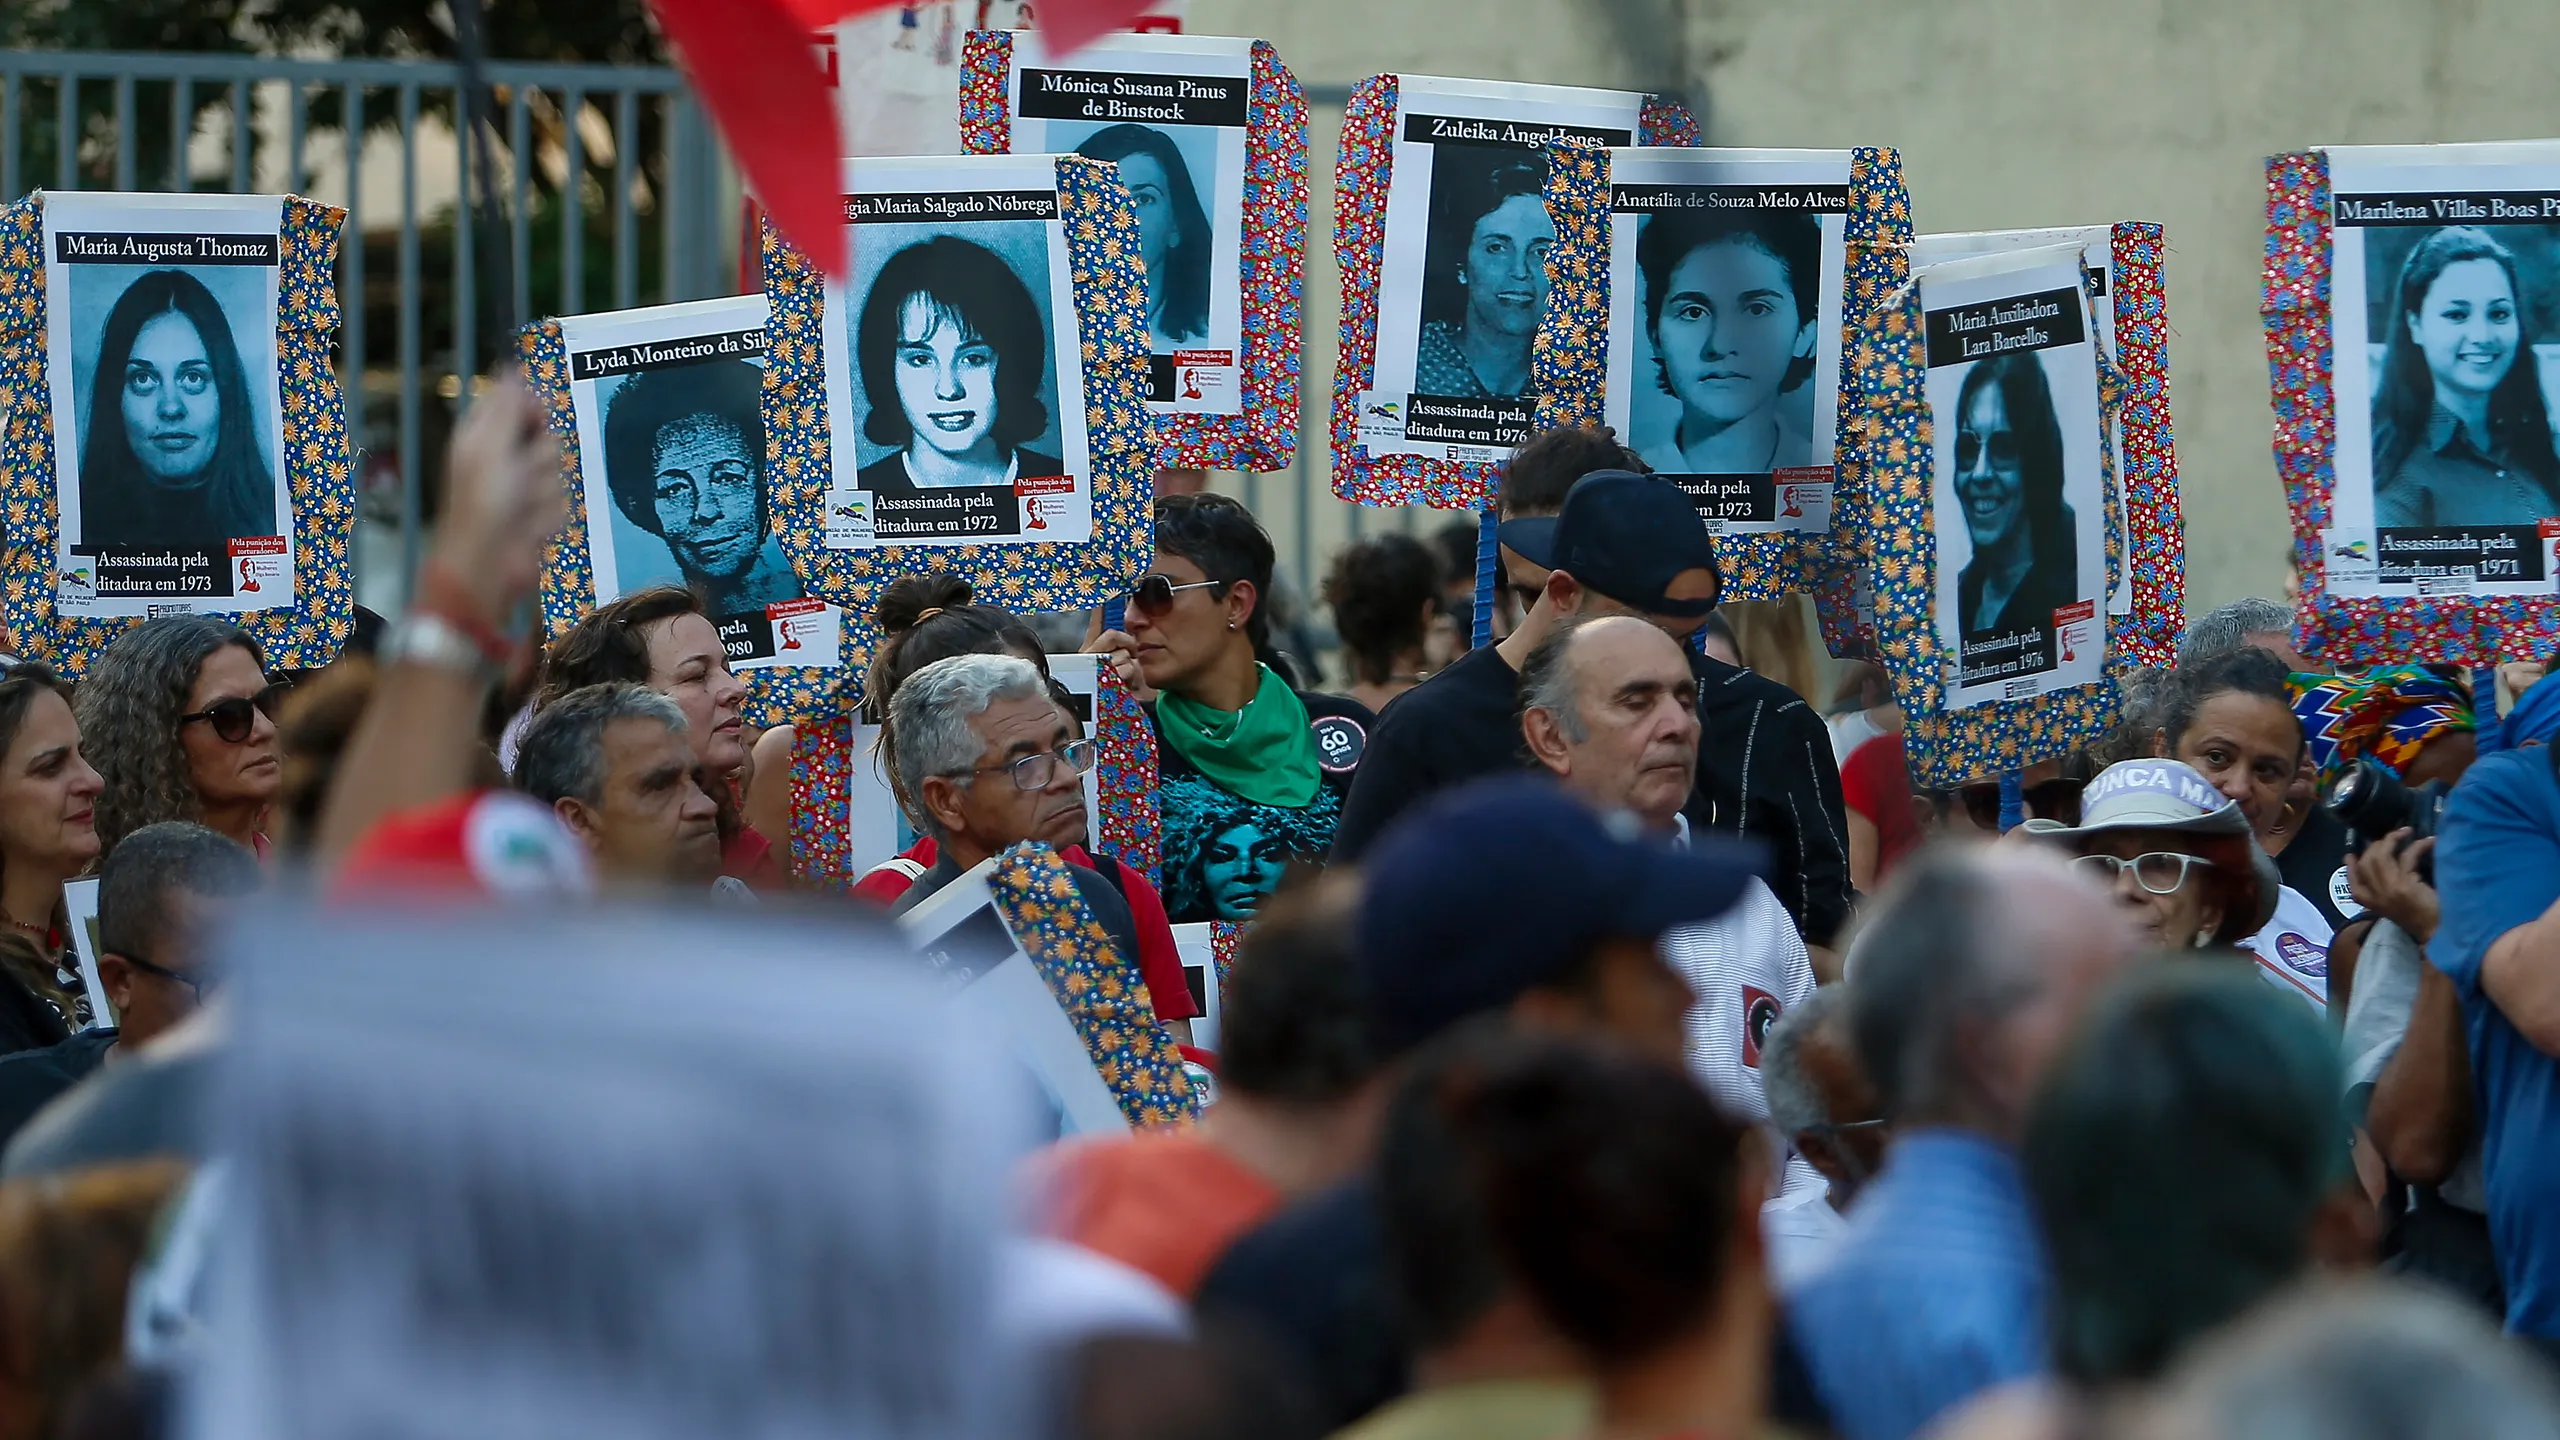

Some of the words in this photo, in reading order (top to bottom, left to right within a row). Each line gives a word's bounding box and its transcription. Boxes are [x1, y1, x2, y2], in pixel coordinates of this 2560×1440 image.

[1041, 74, 1108, 95] Mónica
[1113, 77, 1174, 97] Susana
[1178, 80, 1227, 99] Pinus
[1082, 99, 1103, 116] de
[1107, 100, 1185, 120] Binstock
[1431, 118, 1498, 141] Zuleika
[1501, 124, 1554, 149] Angel
[843, 198, 870, 220] ígia
[874, 198, 920, 215] Maria
[924, 196, 984, 218] Salgado
[987, 196, 1054, 216] Nóbrega
[1614, 191, 1682, 208] Anatália
[1686, 192, 1705, 208] de
[1708, 192, 1755, 208] Souza
[1758, 191, 1800, 208] Melo
[1802, 191, 1846, 208] Alves
[2338, 200, 2428, 221] Marilena
[2430, 198, 2487, 219] Villas
[2489, 197, 2538, 219] Boas
[66, 235, 118, 256] Maria
[122, 236, 193, 261] Augusta
[195, 237, 268, 257] Thomaz
[1949, 311, 1986, 333] Maria
[1989, 299, 2060, 327] Auxiliadora
[1962, 336, 1991, 357] Lara
[1993, 326, 2049, 351] Barcellos
[584, 354, 629, 374] Lyda
[631, 342, 713, 365] Monteiro
[718, 336, 739, 352] da
[1410, 400, 1495, 420] Assassinada
[1498, 406, 1527, 424] pela
[1406, 421, 1465, 440] ditadura
[1468, 430, 1490, 441] em
[1494, 428, 1527, 443] 1976
[1018, 478, 1032, 486] Pela
[1676, 480, 1718, 495] inada
[1721, 480, 1750, 499] pela
[875, 495, 961, 510] Assassinada
[964, 493, 994, 512] pela
[1695, 506, 1713, 516] m
[1717, 502, 1752, 517] 1973
[874, 517, 934, 533] ditadura
[937, 520, 960, 532] em
[963, 516, 998, 531] 1972
[232, 538, 245, 546] Pela
[272, 538, 284, 546] dos
[2379, 533, 2479, 551] Assassinada
[2481, 532, 2518, 555] pela
[98, 551, 178, 568] Assassinada
[182, 553, 209, 572] pela
[2378, 560, 2447, 578] ditadura
[2450, 564, 2477, 577] em
[2479, 559, 2521, 575] 1971
[96, 576, 152, 592] ditadura
[155, 580, 177, 591] em
[180, 576, 212, 591] 1973
[719, 620, 748, 640] pela
[724, 640, 753, 656] 980
[1962, 631, 2019, 656] Assassinada
[2021, 627, 2042, 649] pela
[1961, 661, 2000, 681] ditadura
[2002, 663, 2018, 674] em
[2020, 651, 2044, 670] 1976
[1321, 730, 1349, 751] 60
